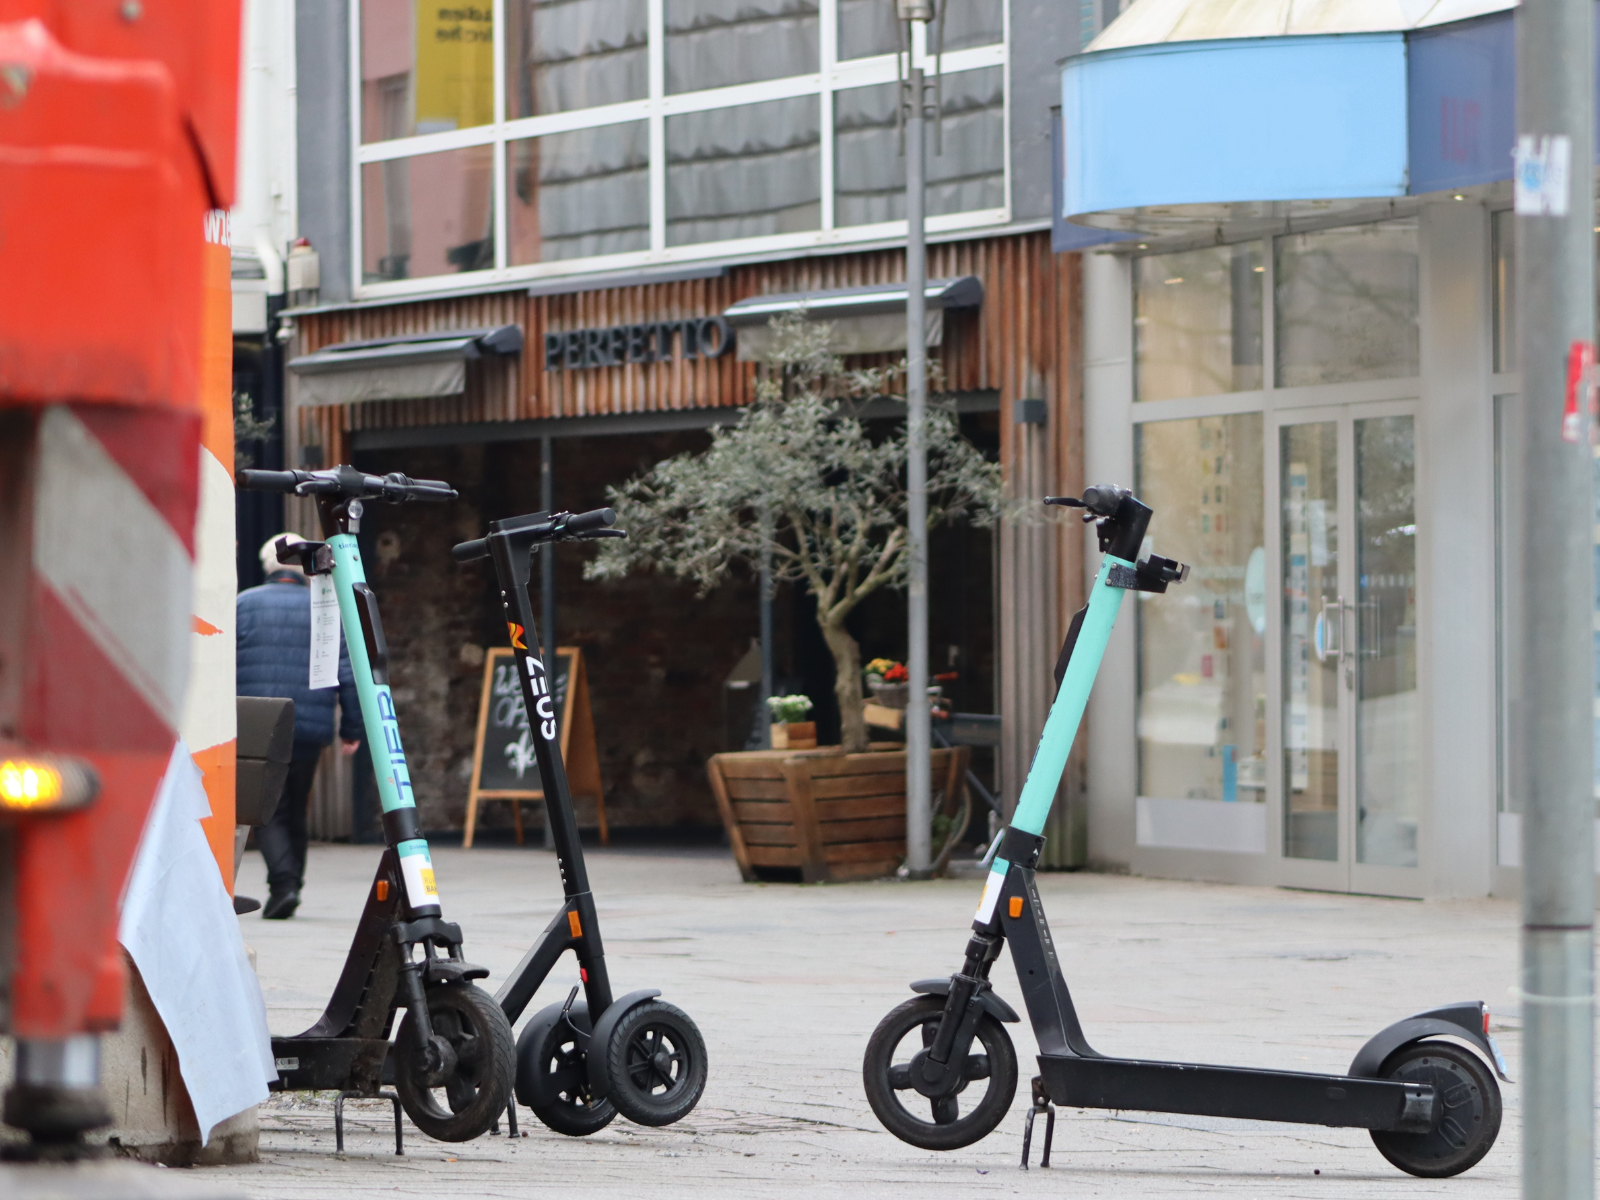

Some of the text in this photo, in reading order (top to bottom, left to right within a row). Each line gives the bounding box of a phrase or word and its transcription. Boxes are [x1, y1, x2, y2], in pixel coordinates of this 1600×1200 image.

[544, 316, 731, 371] PERFETTO
[525, 655, 556, 740] ZEUS
[376, 691, 411, 800] TIER
